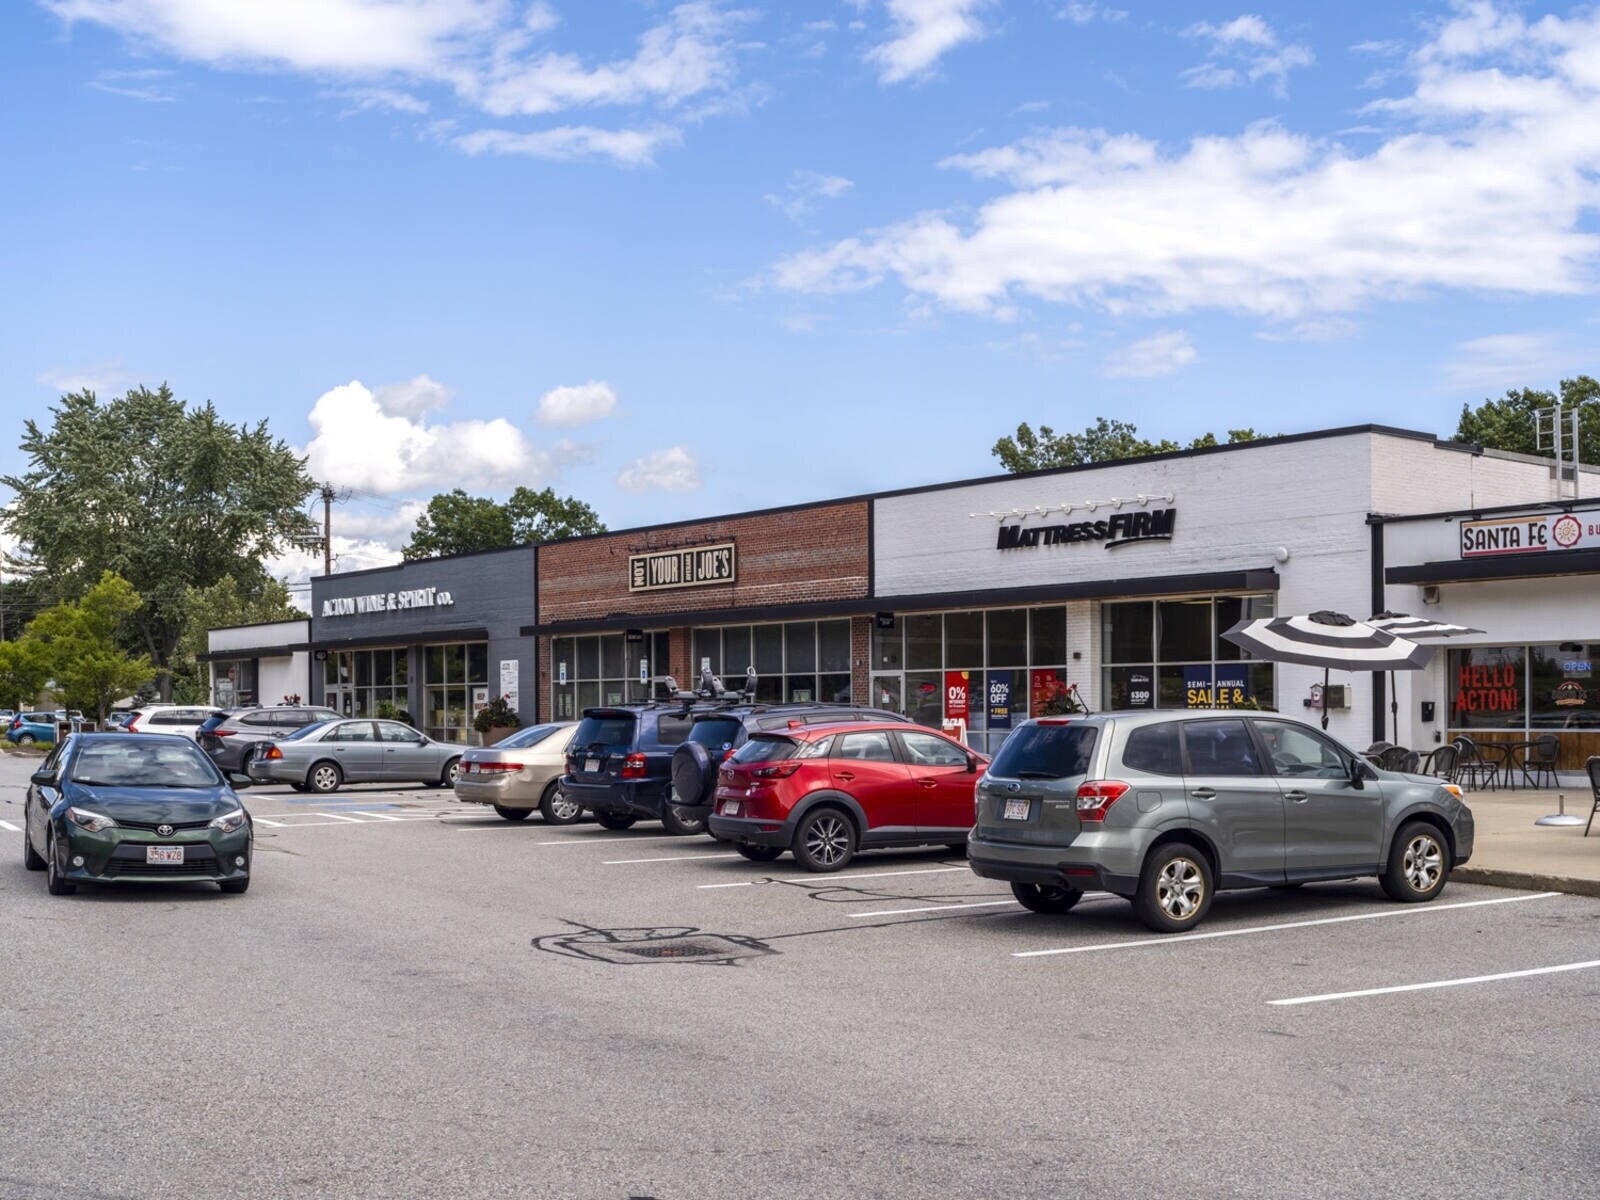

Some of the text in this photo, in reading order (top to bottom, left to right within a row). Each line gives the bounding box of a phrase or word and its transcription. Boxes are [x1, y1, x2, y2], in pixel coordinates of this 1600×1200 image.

[1463, 522, 1548, 551] SANTA FE
[633, 560, 645, 587] NOT
[650, 556, 679, 585] YOUR
[697, 549, 730, 580] JOE'S
[321, 597, 356, 617] ACTON
[356, 593, 386, 614] WINE
[386, 592, 398, 611] &
[1458, 663, 1516, 688] HELLO
[1562, 661, 1593, 672] OPEN
[948, 685, 967, 700] 0%
[990, 683, 1009, 694] 60%
[1187, 688, 1244, 704] SALE &
[990, 694, 1007, 704] OFF
[1456, 688, 1519, 712] ACTON!
